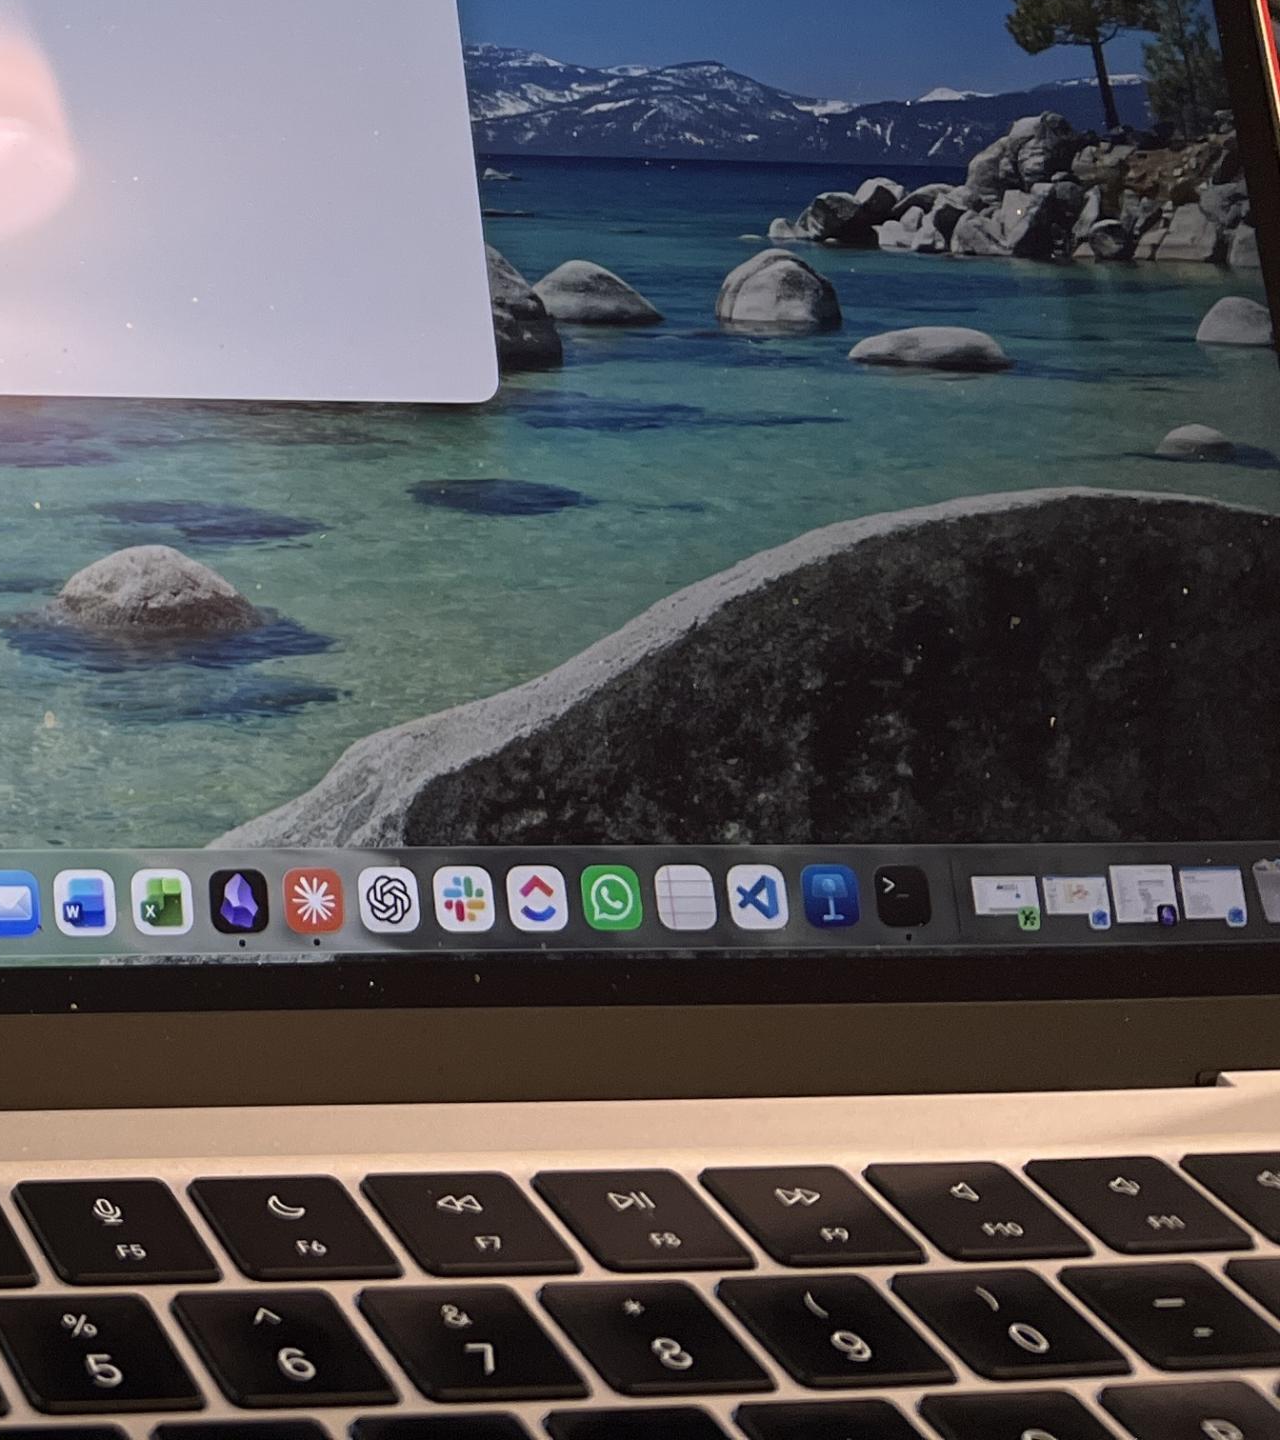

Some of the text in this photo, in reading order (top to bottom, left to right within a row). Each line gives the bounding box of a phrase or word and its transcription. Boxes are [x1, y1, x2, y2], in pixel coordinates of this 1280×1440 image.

[116, 1243, 147, 1261] F5
[295, 1238, 328, 1258] F6
[464, 1341, 496, 1376] 7
[650, 1336, 694, 1370] 8
[829, 1329, 873, 1362] 9
[85, 1353, 124, 1389] 5
[276, 1347, 316, 1382] 6
